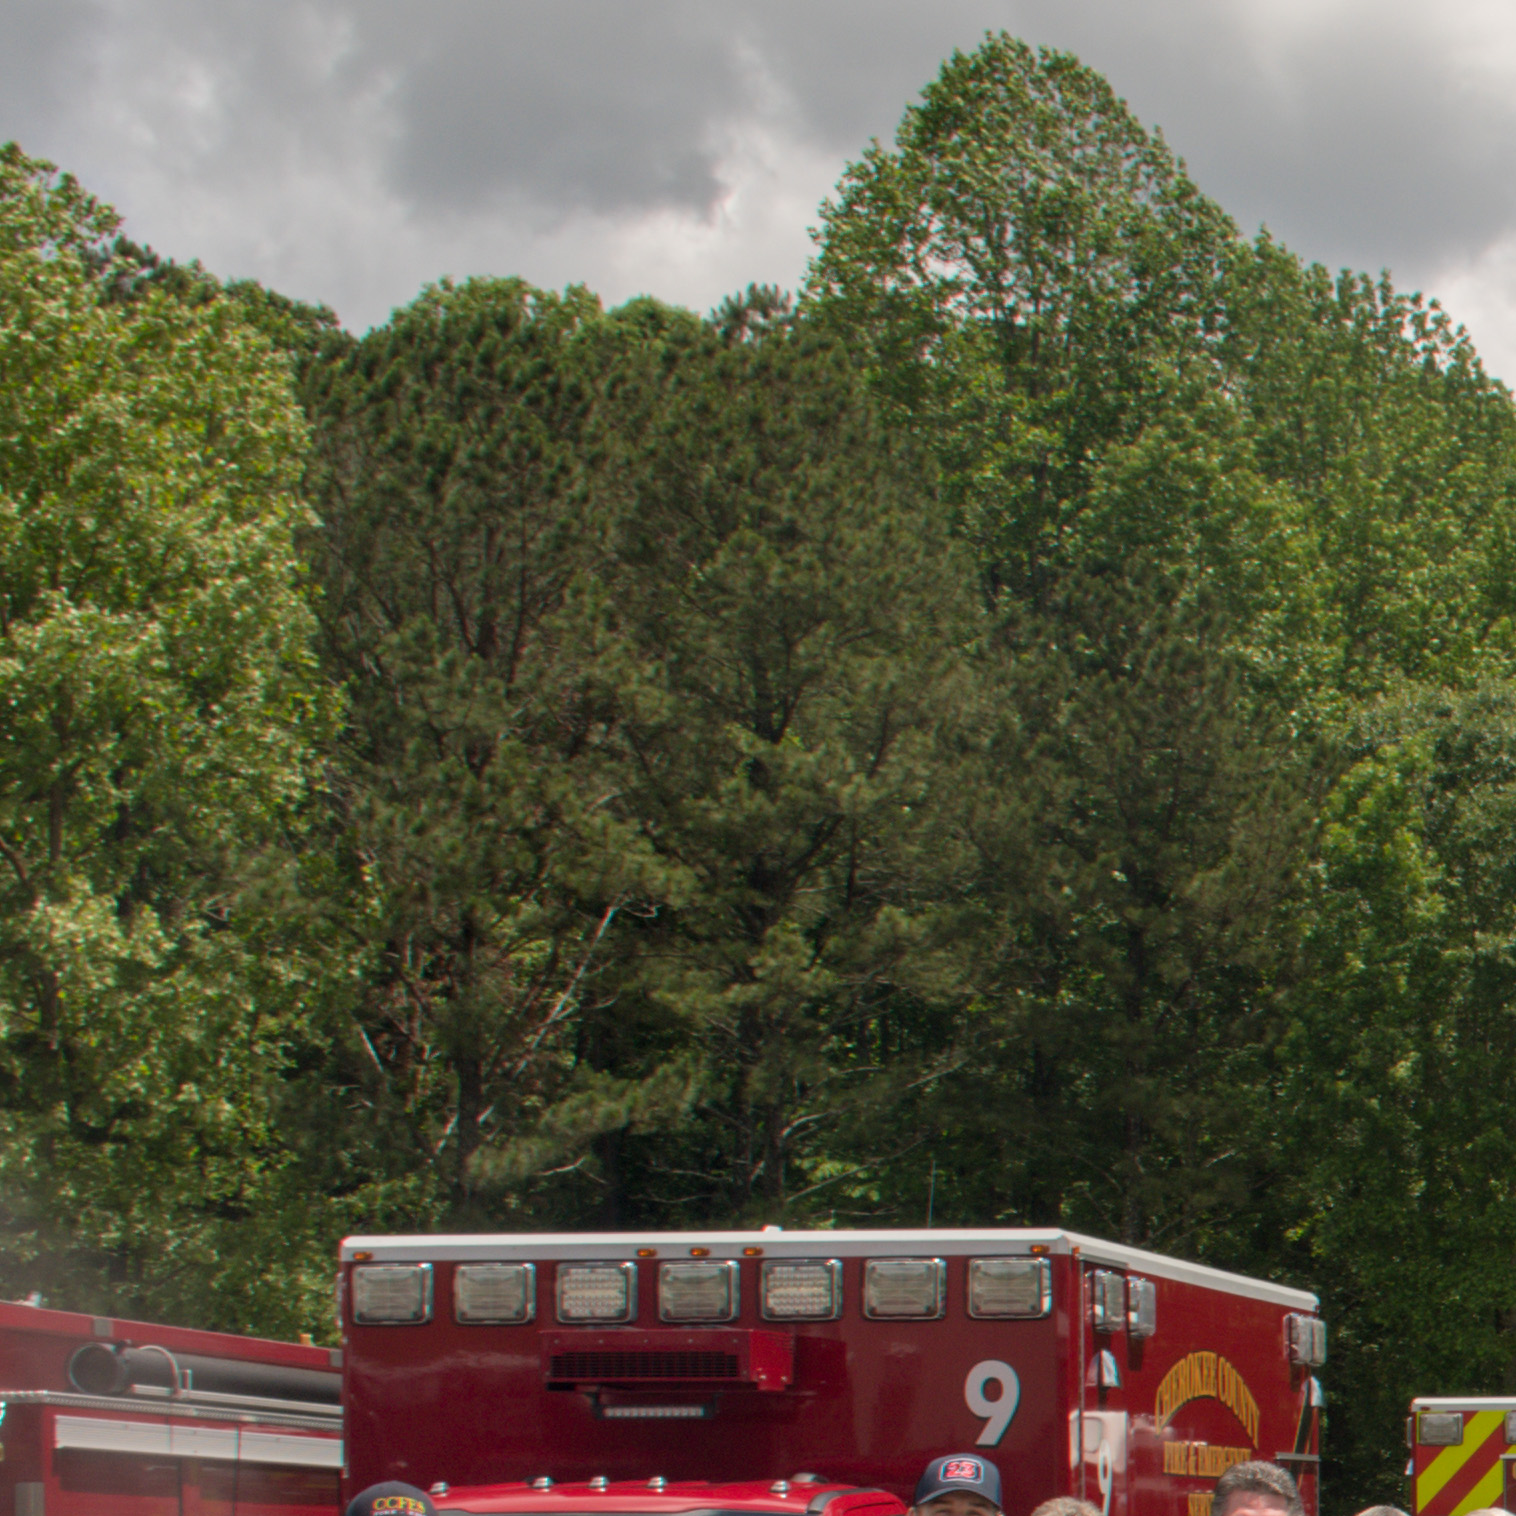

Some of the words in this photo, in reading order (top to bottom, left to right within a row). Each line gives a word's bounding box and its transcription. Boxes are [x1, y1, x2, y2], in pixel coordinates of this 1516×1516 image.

[964, 1360, 1020, 1446] 9
[1155, 1351, 1217, 1436] CHEROKEE
[1219, 1356, 1260, 1449] COUNTY
[946, 1461, 976, 1478] 23
[372, 1496, 426, 1513] CCFES
